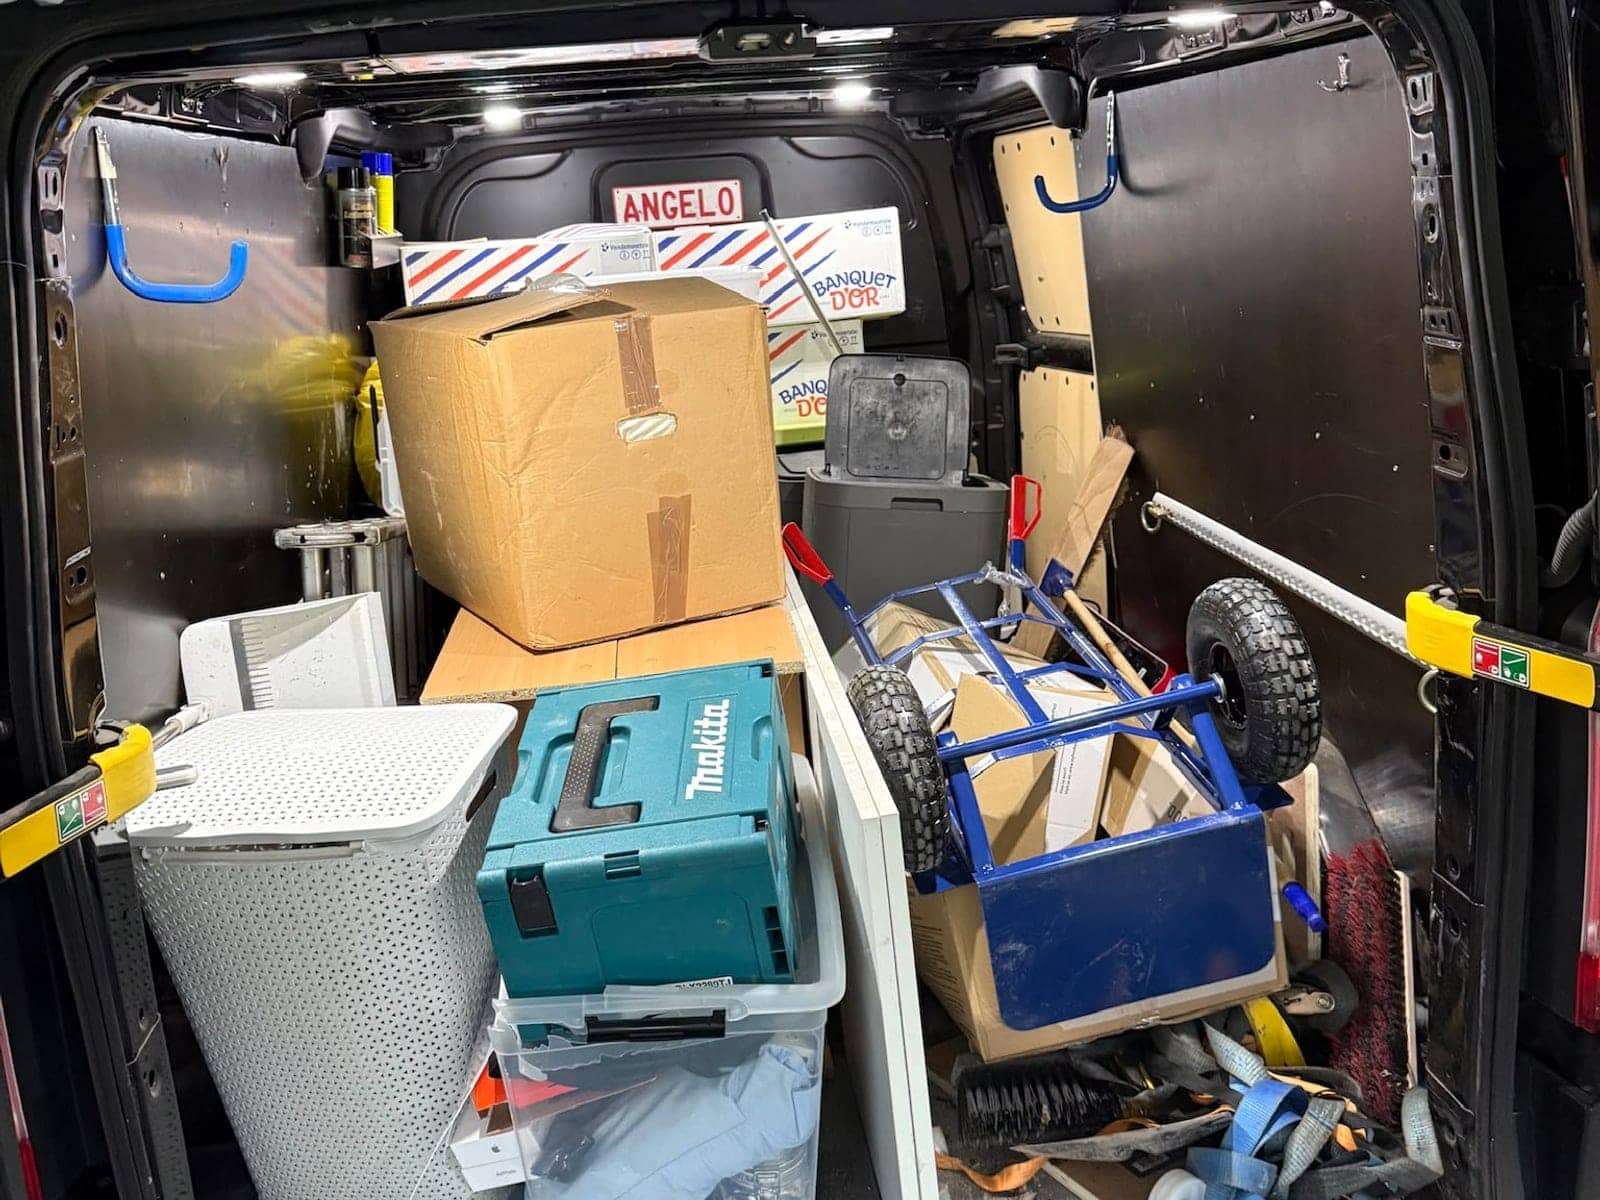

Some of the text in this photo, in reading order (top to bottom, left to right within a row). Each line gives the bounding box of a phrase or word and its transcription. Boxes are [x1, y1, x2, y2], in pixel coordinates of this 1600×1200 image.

[623, 186, 734, 223] ANGELO
[829, 286, 880, 311] D'OR
[778, 379, 828, 404] BANQ
[796, 396, 828, 417] D'O
